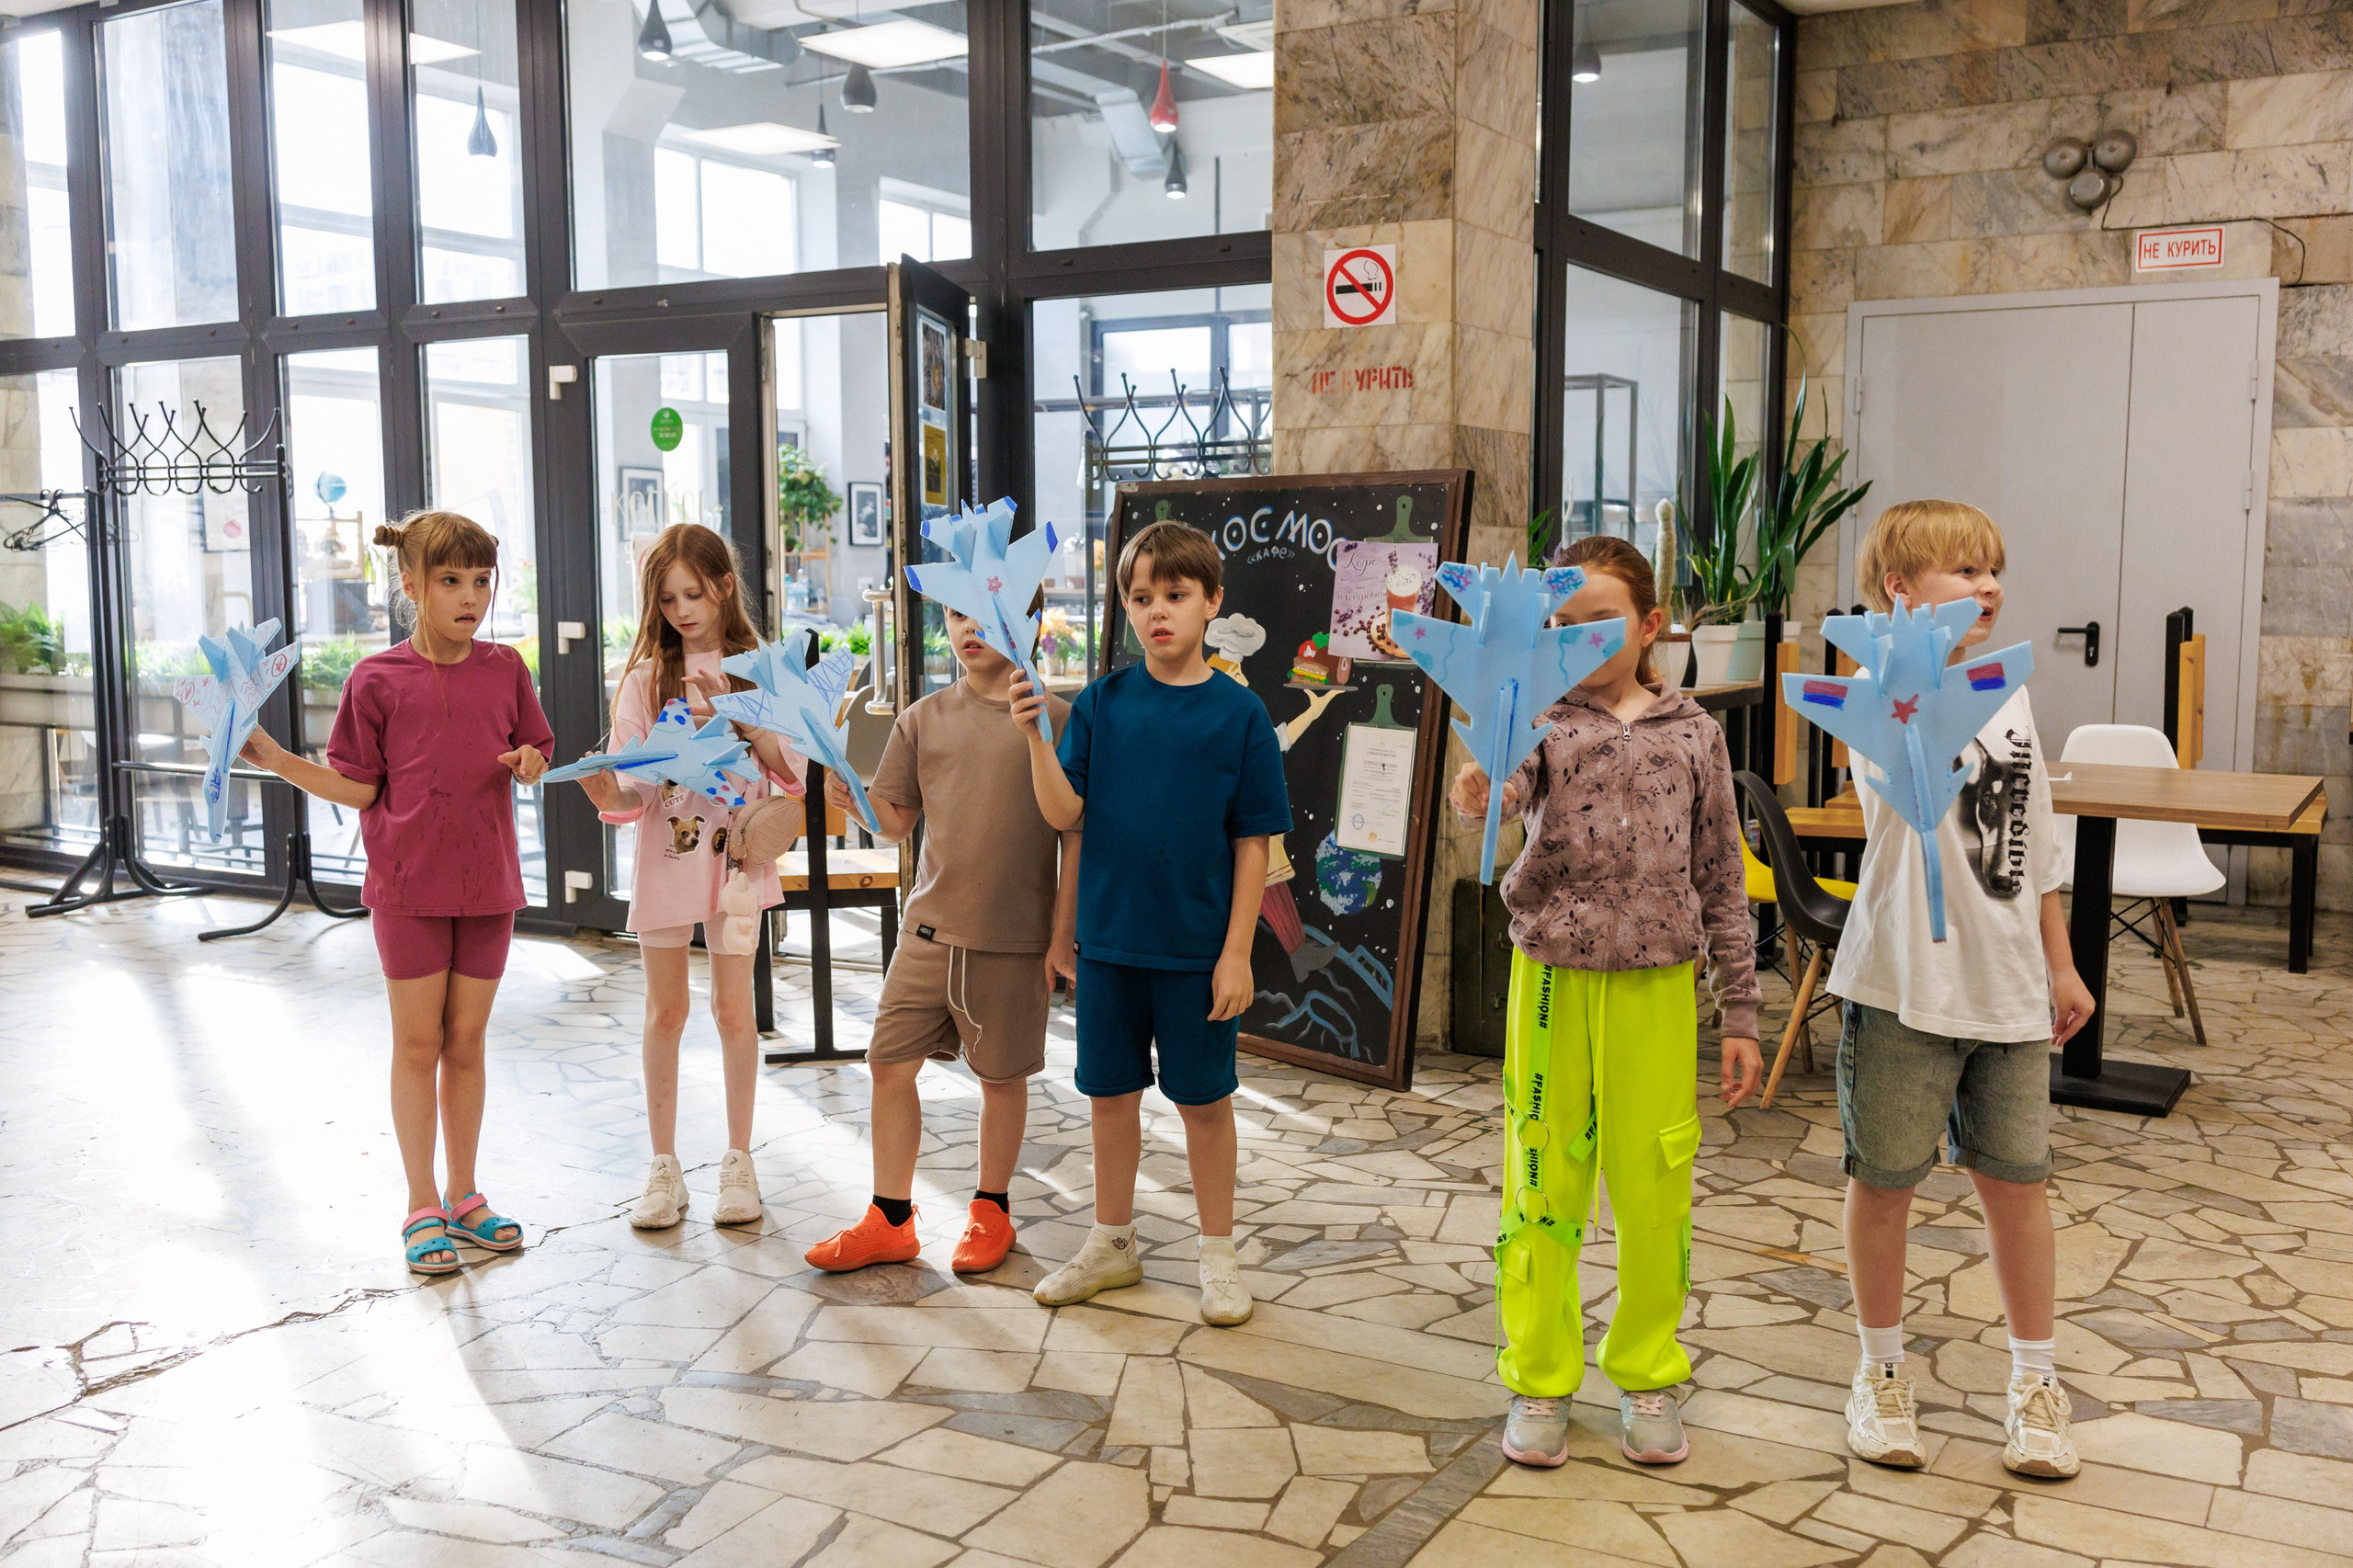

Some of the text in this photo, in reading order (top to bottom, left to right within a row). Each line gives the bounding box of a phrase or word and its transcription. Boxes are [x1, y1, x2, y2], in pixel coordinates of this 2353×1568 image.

[2143, 239, 2216, 259] НЕ КУРИТЬ
[665, 794, 685, 808] CUTE
